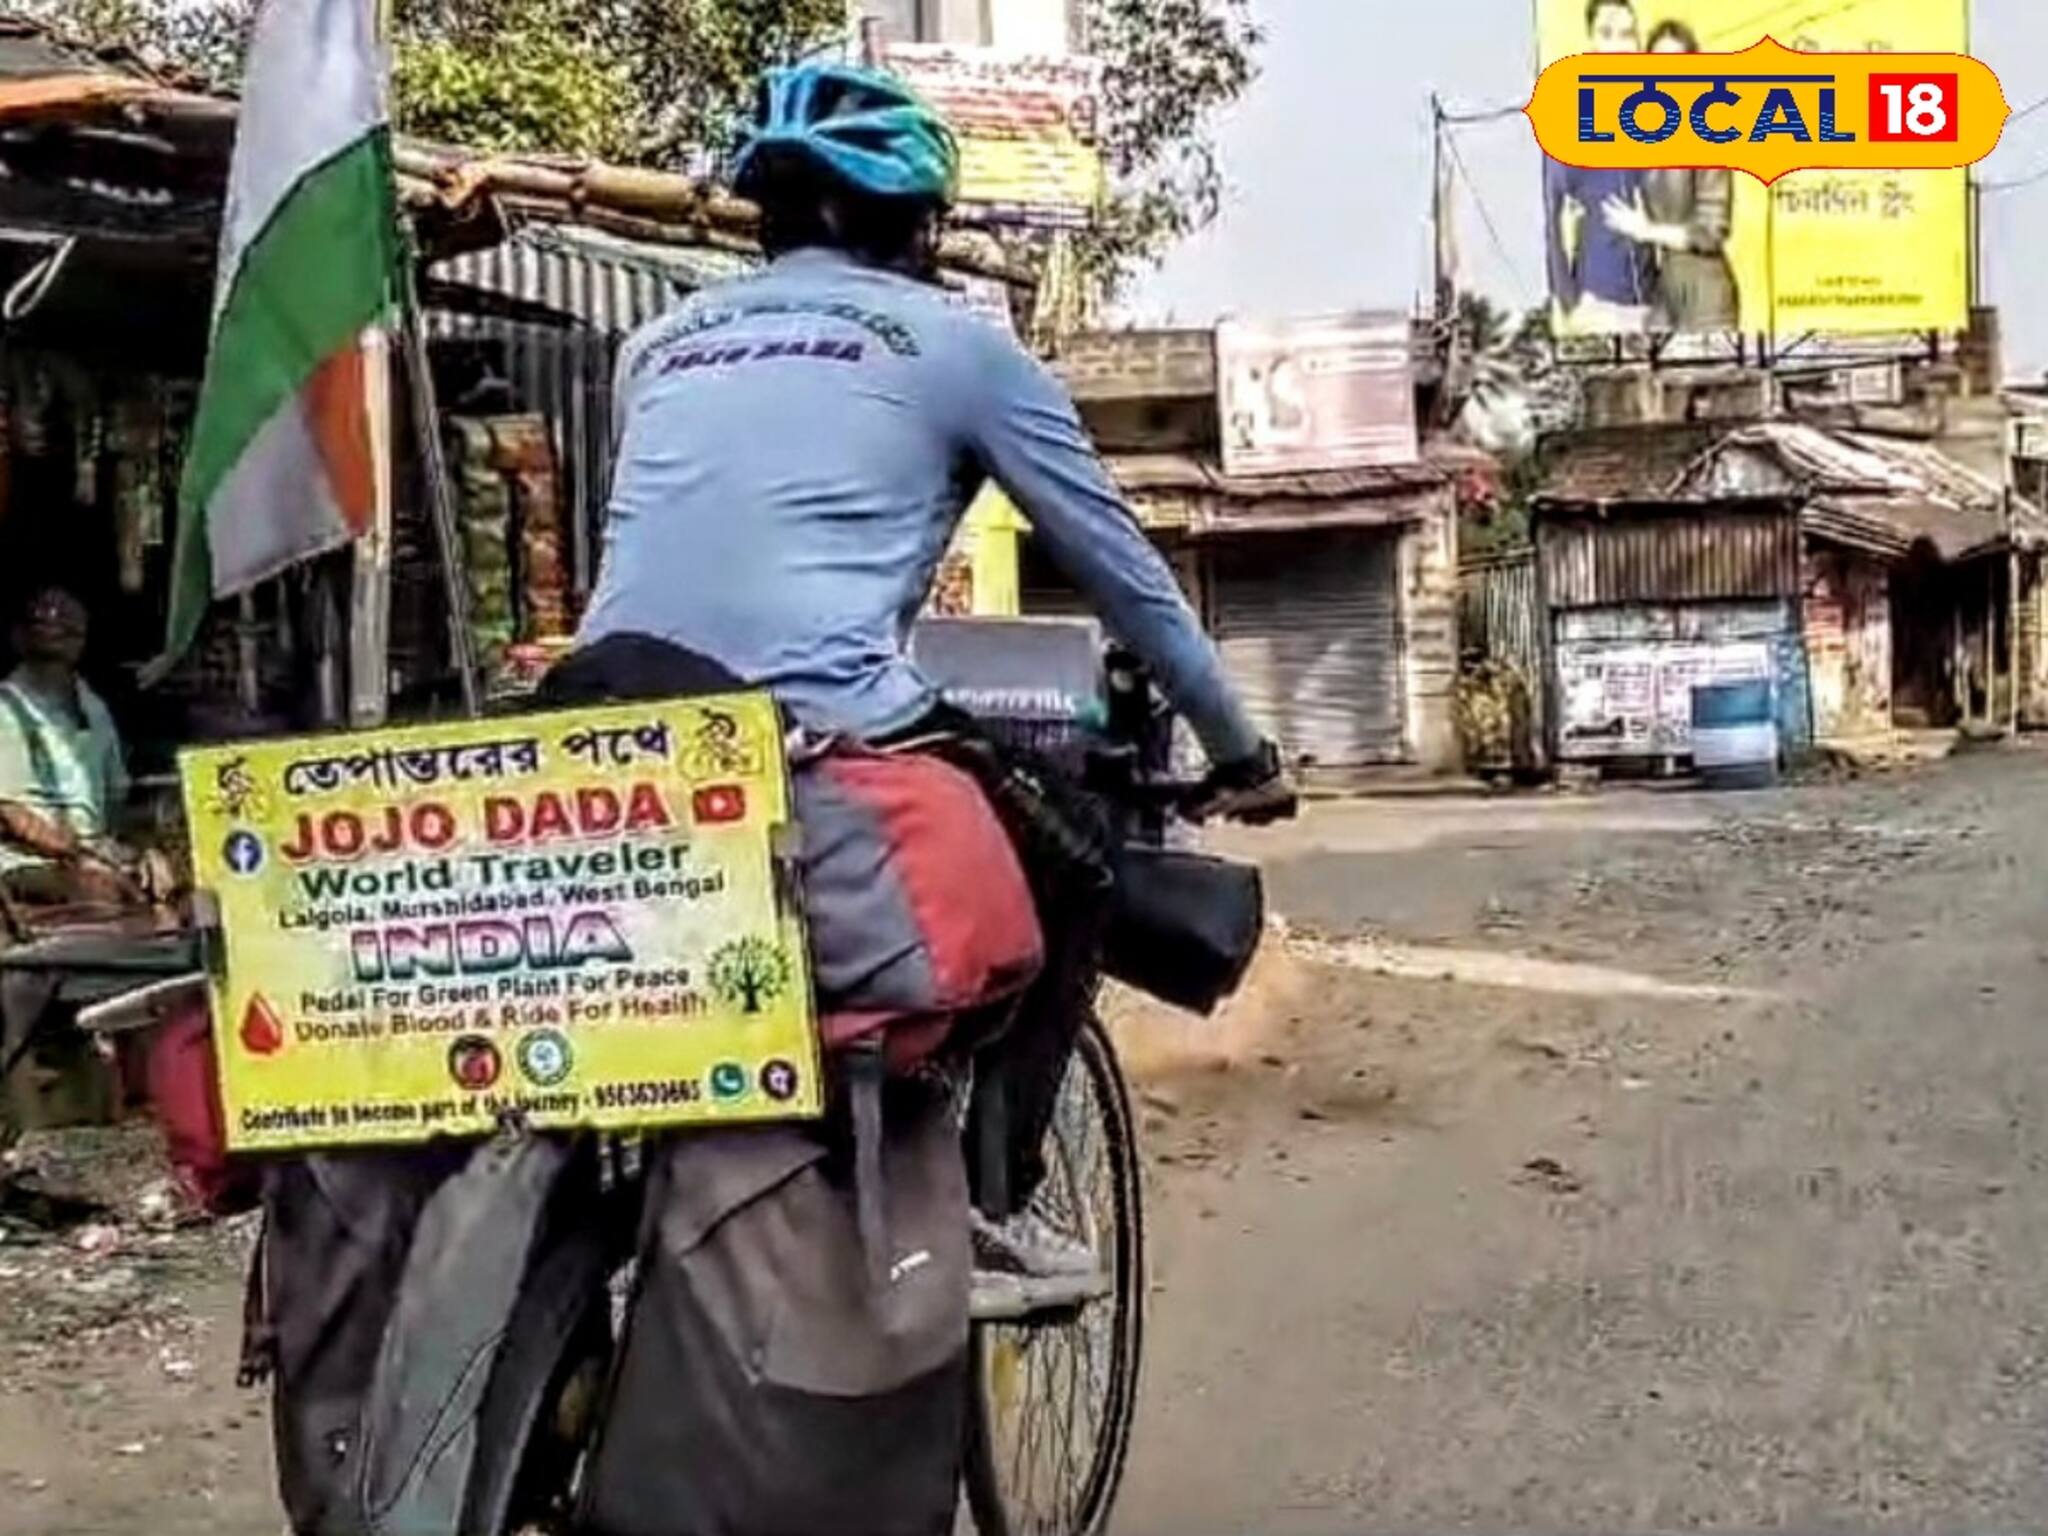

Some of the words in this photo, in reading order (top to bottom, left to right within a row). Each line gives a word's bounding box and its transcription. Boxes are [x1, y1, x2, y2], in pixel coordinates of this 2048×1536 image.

[280, 802, 456, 861] JOJO
[484, 782, 671, 841] DADA
[300, 859, 452, 900] World
[470, 842, 691, 885] Traveler
[560, 879, 628, 905] West
[633, 871, 724, 899] Bengal
[351, 911, 634, 982] INDIA
[301, 991, 365, 1014] Pedal
[373, 987, 413, 1009] For
[418, 981, 489, 1004] Green
[498, 974, 565, 998] Plant
[568, 971, 608, 993] For
[616, 966, 690, 989] Peace
[295, 1019, 384, 1042] Donate
[391, 1010, 466, 1034] Blood
[475, 1008, 492, 1029] &
[500, 1003, 560, 1026] Ride
[568, 998, 612, 1022] For
[621, 992, 708, 1017] Health
[331, 1104, 349, 1126] to
[353, 1103, 417, 1122] become
[421, 1100, 456, 1124] part
[461, 1095, 477, 1116] of
